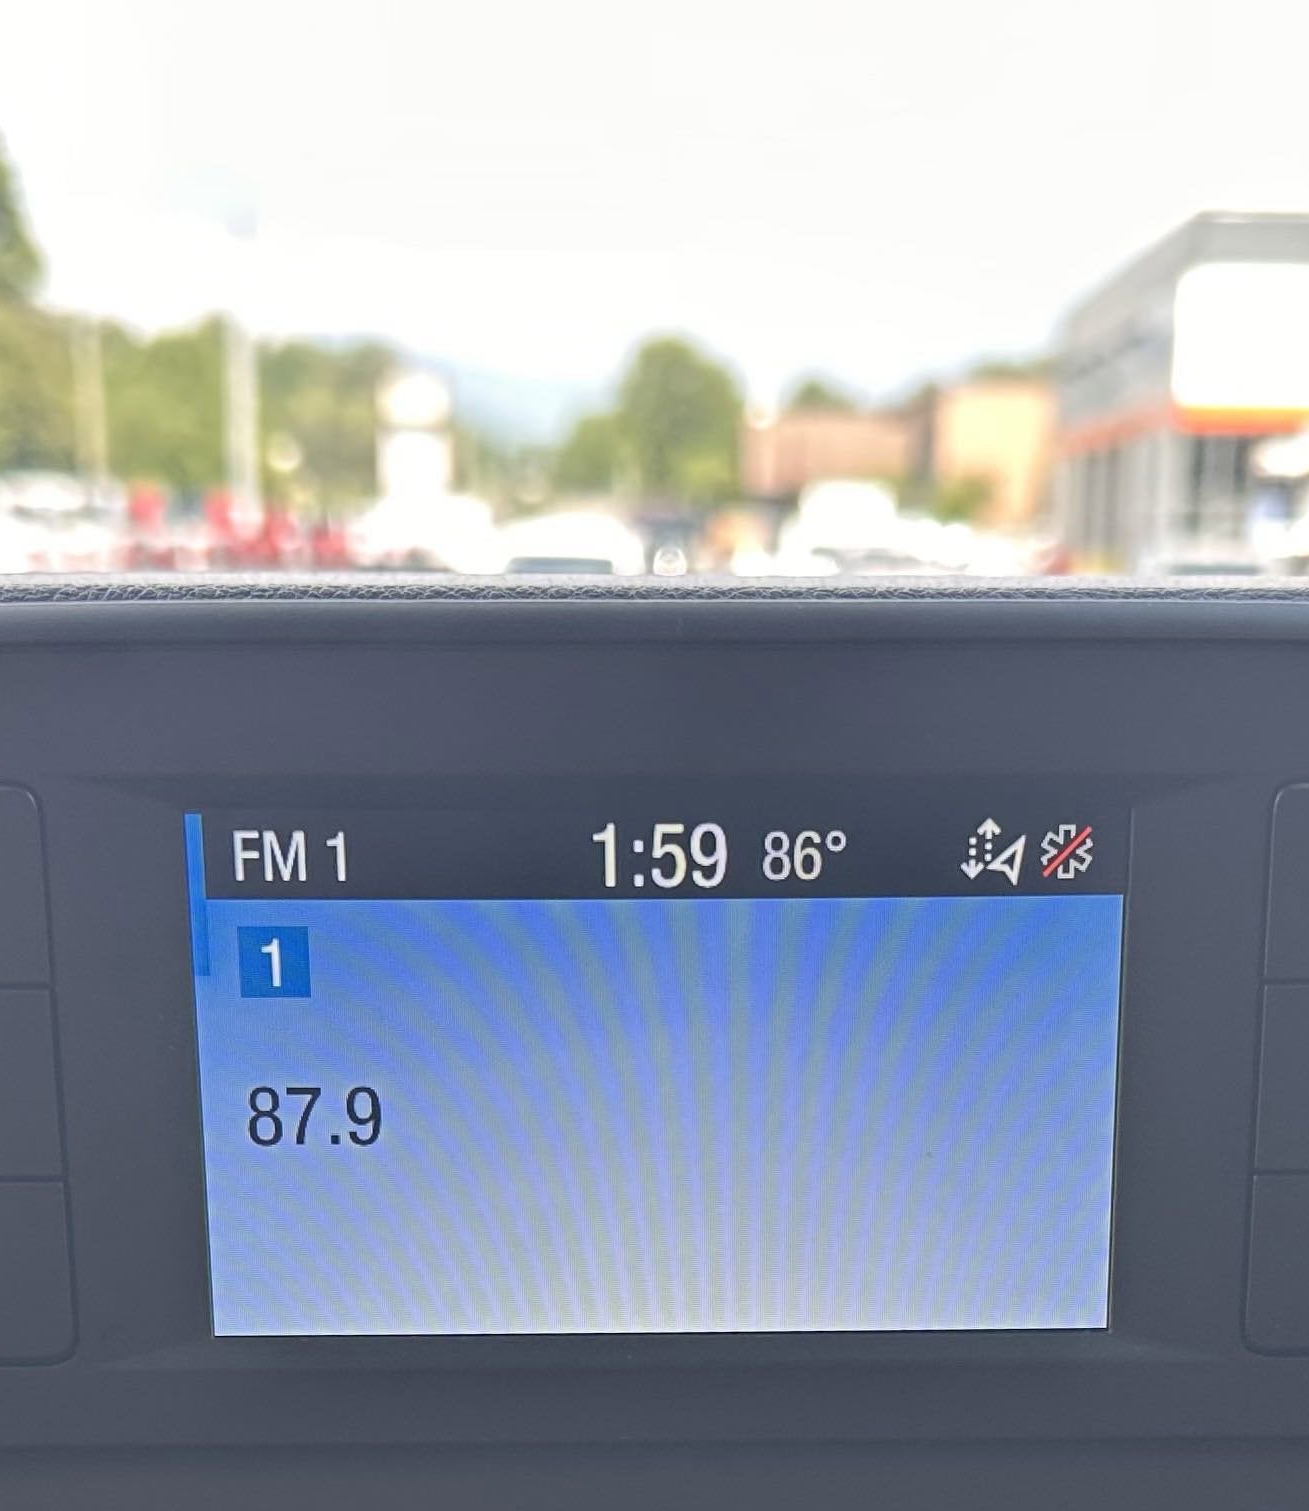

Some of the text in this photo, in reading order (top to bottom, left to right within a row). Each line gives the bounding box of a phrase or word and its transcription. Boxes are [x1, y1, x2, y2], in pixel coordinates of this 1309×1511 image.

[232, 830, 349, 882] FM 1
[591, 823, 728, 889] 1:59
[761, 830, 848, 882] 86°
[260, 938, 284, 988] 1
[246, 1085, 384, 1147] 87.9
